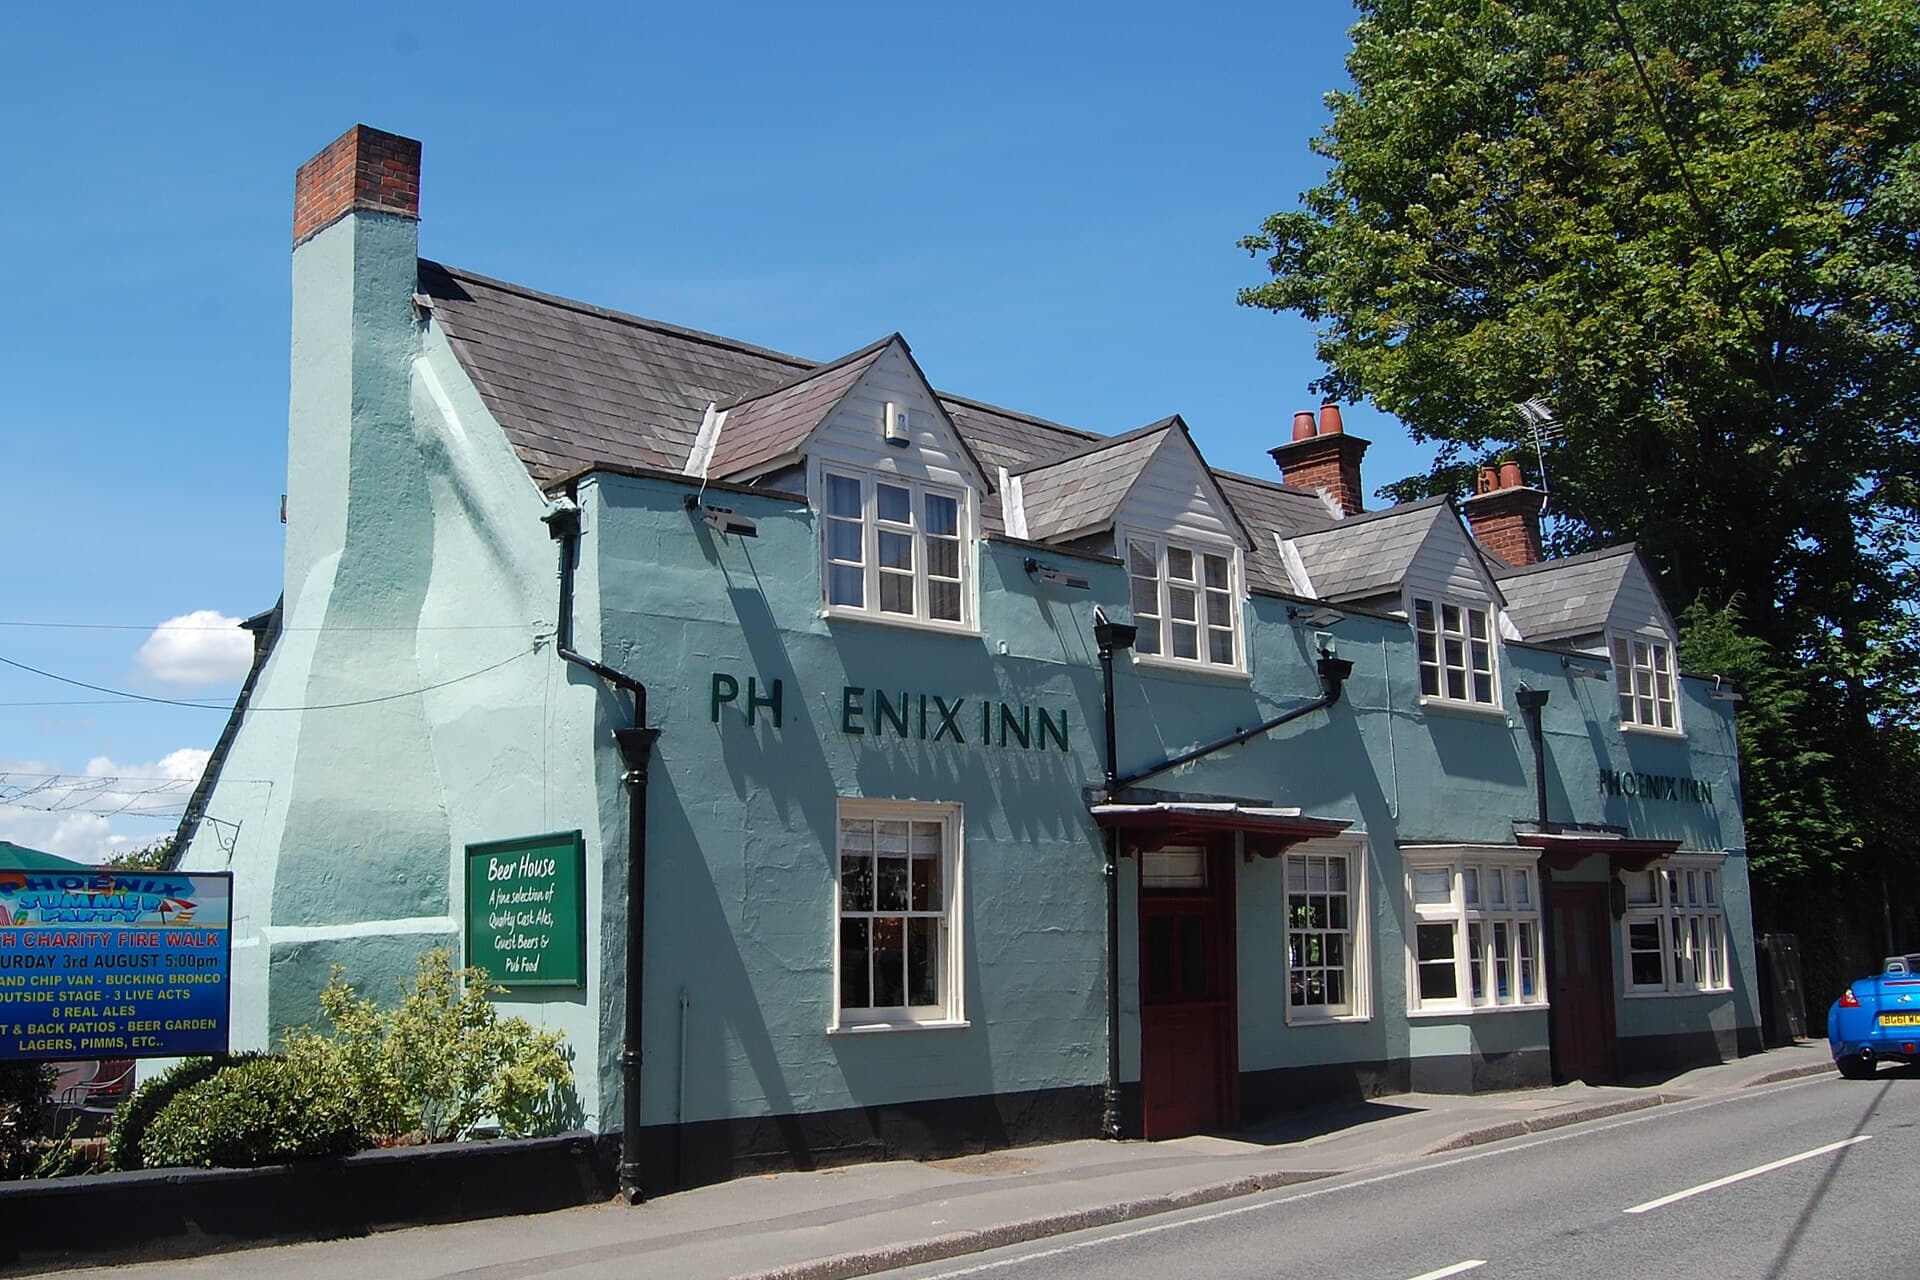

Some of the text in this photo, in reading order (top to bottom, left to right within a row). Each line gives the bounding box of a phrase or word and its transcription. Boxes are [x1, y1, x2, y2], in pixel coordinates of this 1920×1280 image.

[983, 700, 1069, 752] INN
[1600, 768, 1713, 804] PHOENIX INN
[488, 853, 556, 882] Beer House
[0, 876, 186, 897] HOENIX
[19, 893, 161, 911] SUMMER
[489, 882, 555, 910] A fine selection of
[40, 908, 142, 923] PARTY
[488, 910, 516, 936] Quality
[535, 907, 554, 928] Ales,
[0, 932, 219, 948] H CHARITY FIRE WALK
[494, 934, 517, 952] Guest
[517, 933, 539, 949] Beers
[63, 954, 88, 969] 3rd
[94, 954, 159, 968] AUGUST
[165, 953, 218, 970] 5:00pm
[505, 953, 540, 973] Pub Food
[30, 975, 62, 986] CHIP
[67, 975, 94, 985] VAN
[106, 974, 164, 985] BUCKING
[169, 973, 221, 984] BRONCO
[59, 990, 102, 1002] STAGE
[114, 990, 121, 1001] 3
[125, 989, 154, 1001] LIVE
[158, 989, 191, 1000] ACTS
[52, 1005, 136, 1018] 8 REAL ALES
[13, 1023, 22, 1035] &
[27, 1023, 64, 1035] BACK
[69, 1021, 116, 1033] PATIOS
[127, 1020, 161, 1032] BEER
[165, 1019, 217, 1031] GARDEN
[19, 1039, 77, 1052] LAGERS,
[81, 1037, 128, 1049] PIMMS,
